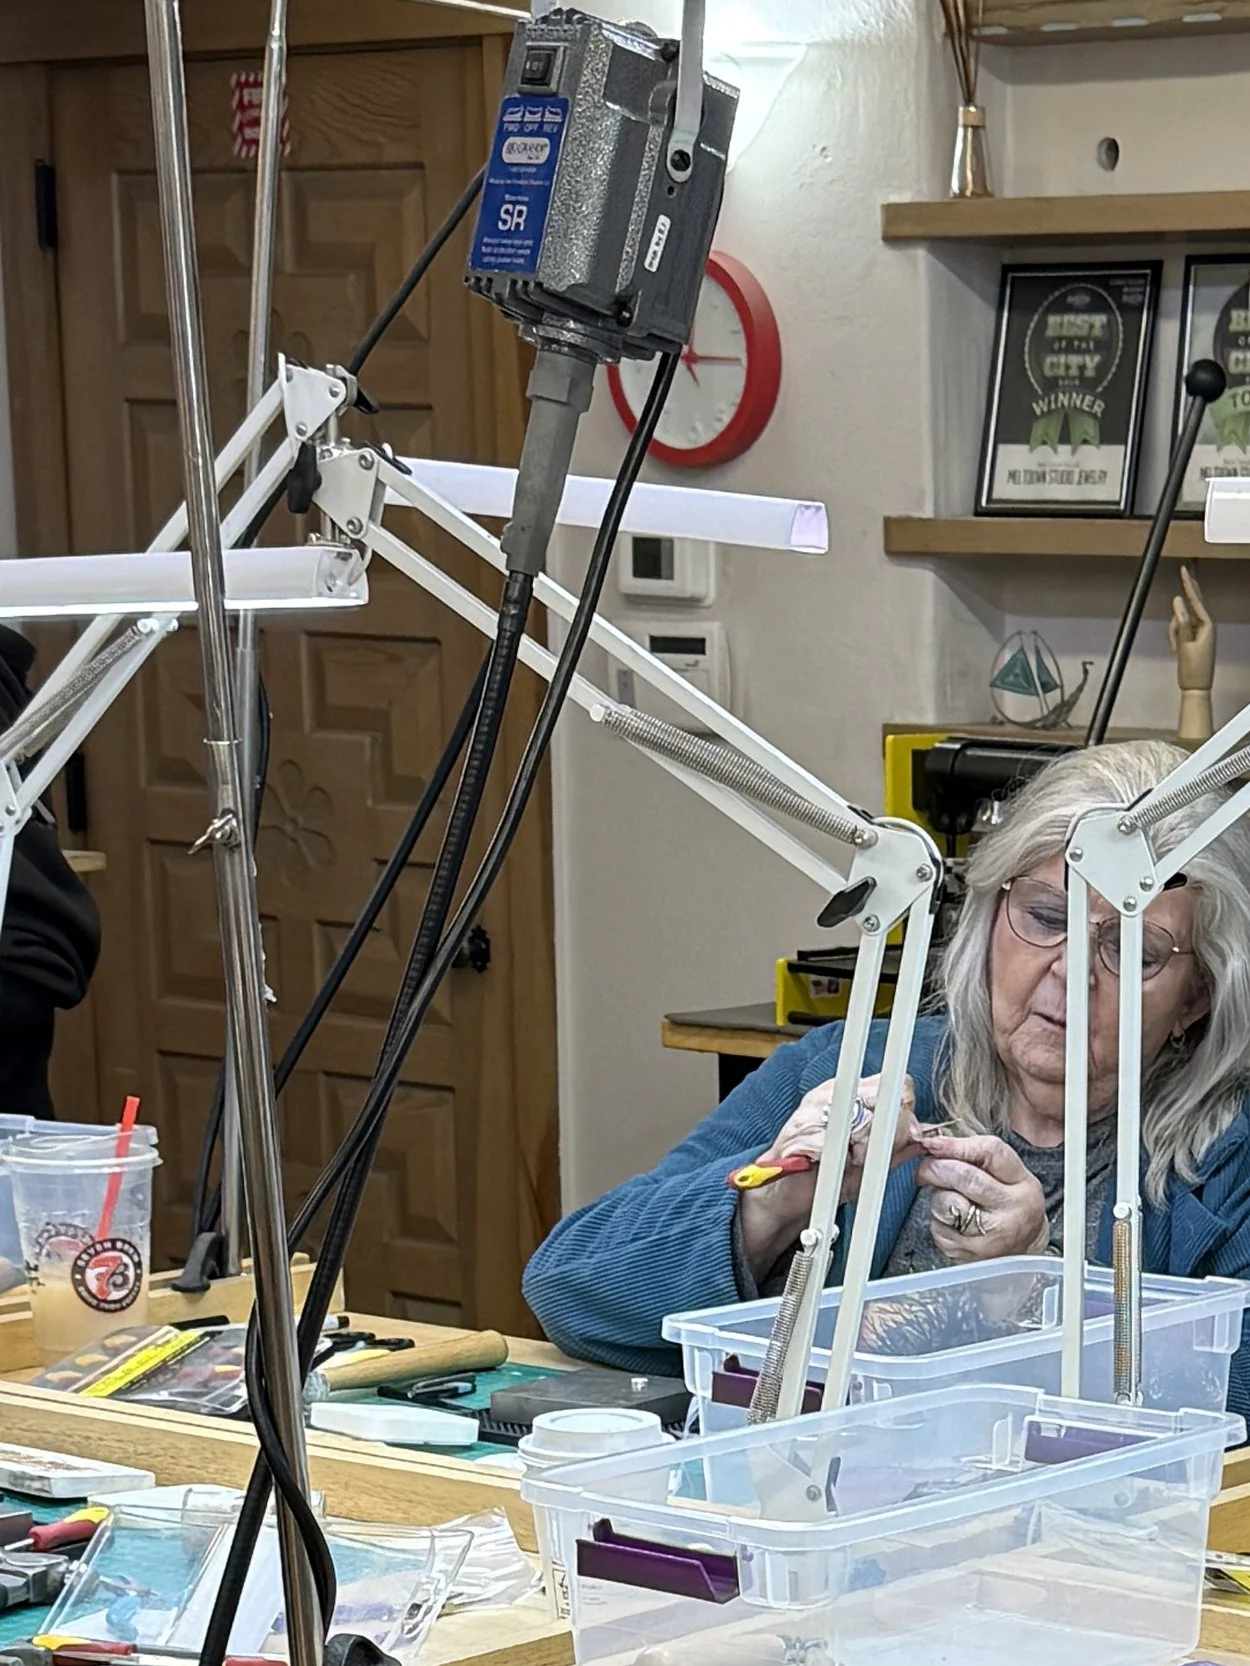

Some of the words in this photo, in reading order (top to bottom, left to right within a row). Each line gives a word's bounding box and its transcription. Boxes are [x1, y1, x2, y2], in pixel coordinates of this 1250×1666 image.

[497, 203, 527, 231] SR
[1045, 313, 1107, 338] BEST
[1043, 353, 1100, 378] CITY
[1031, 391, 1106, 418] WINNER
